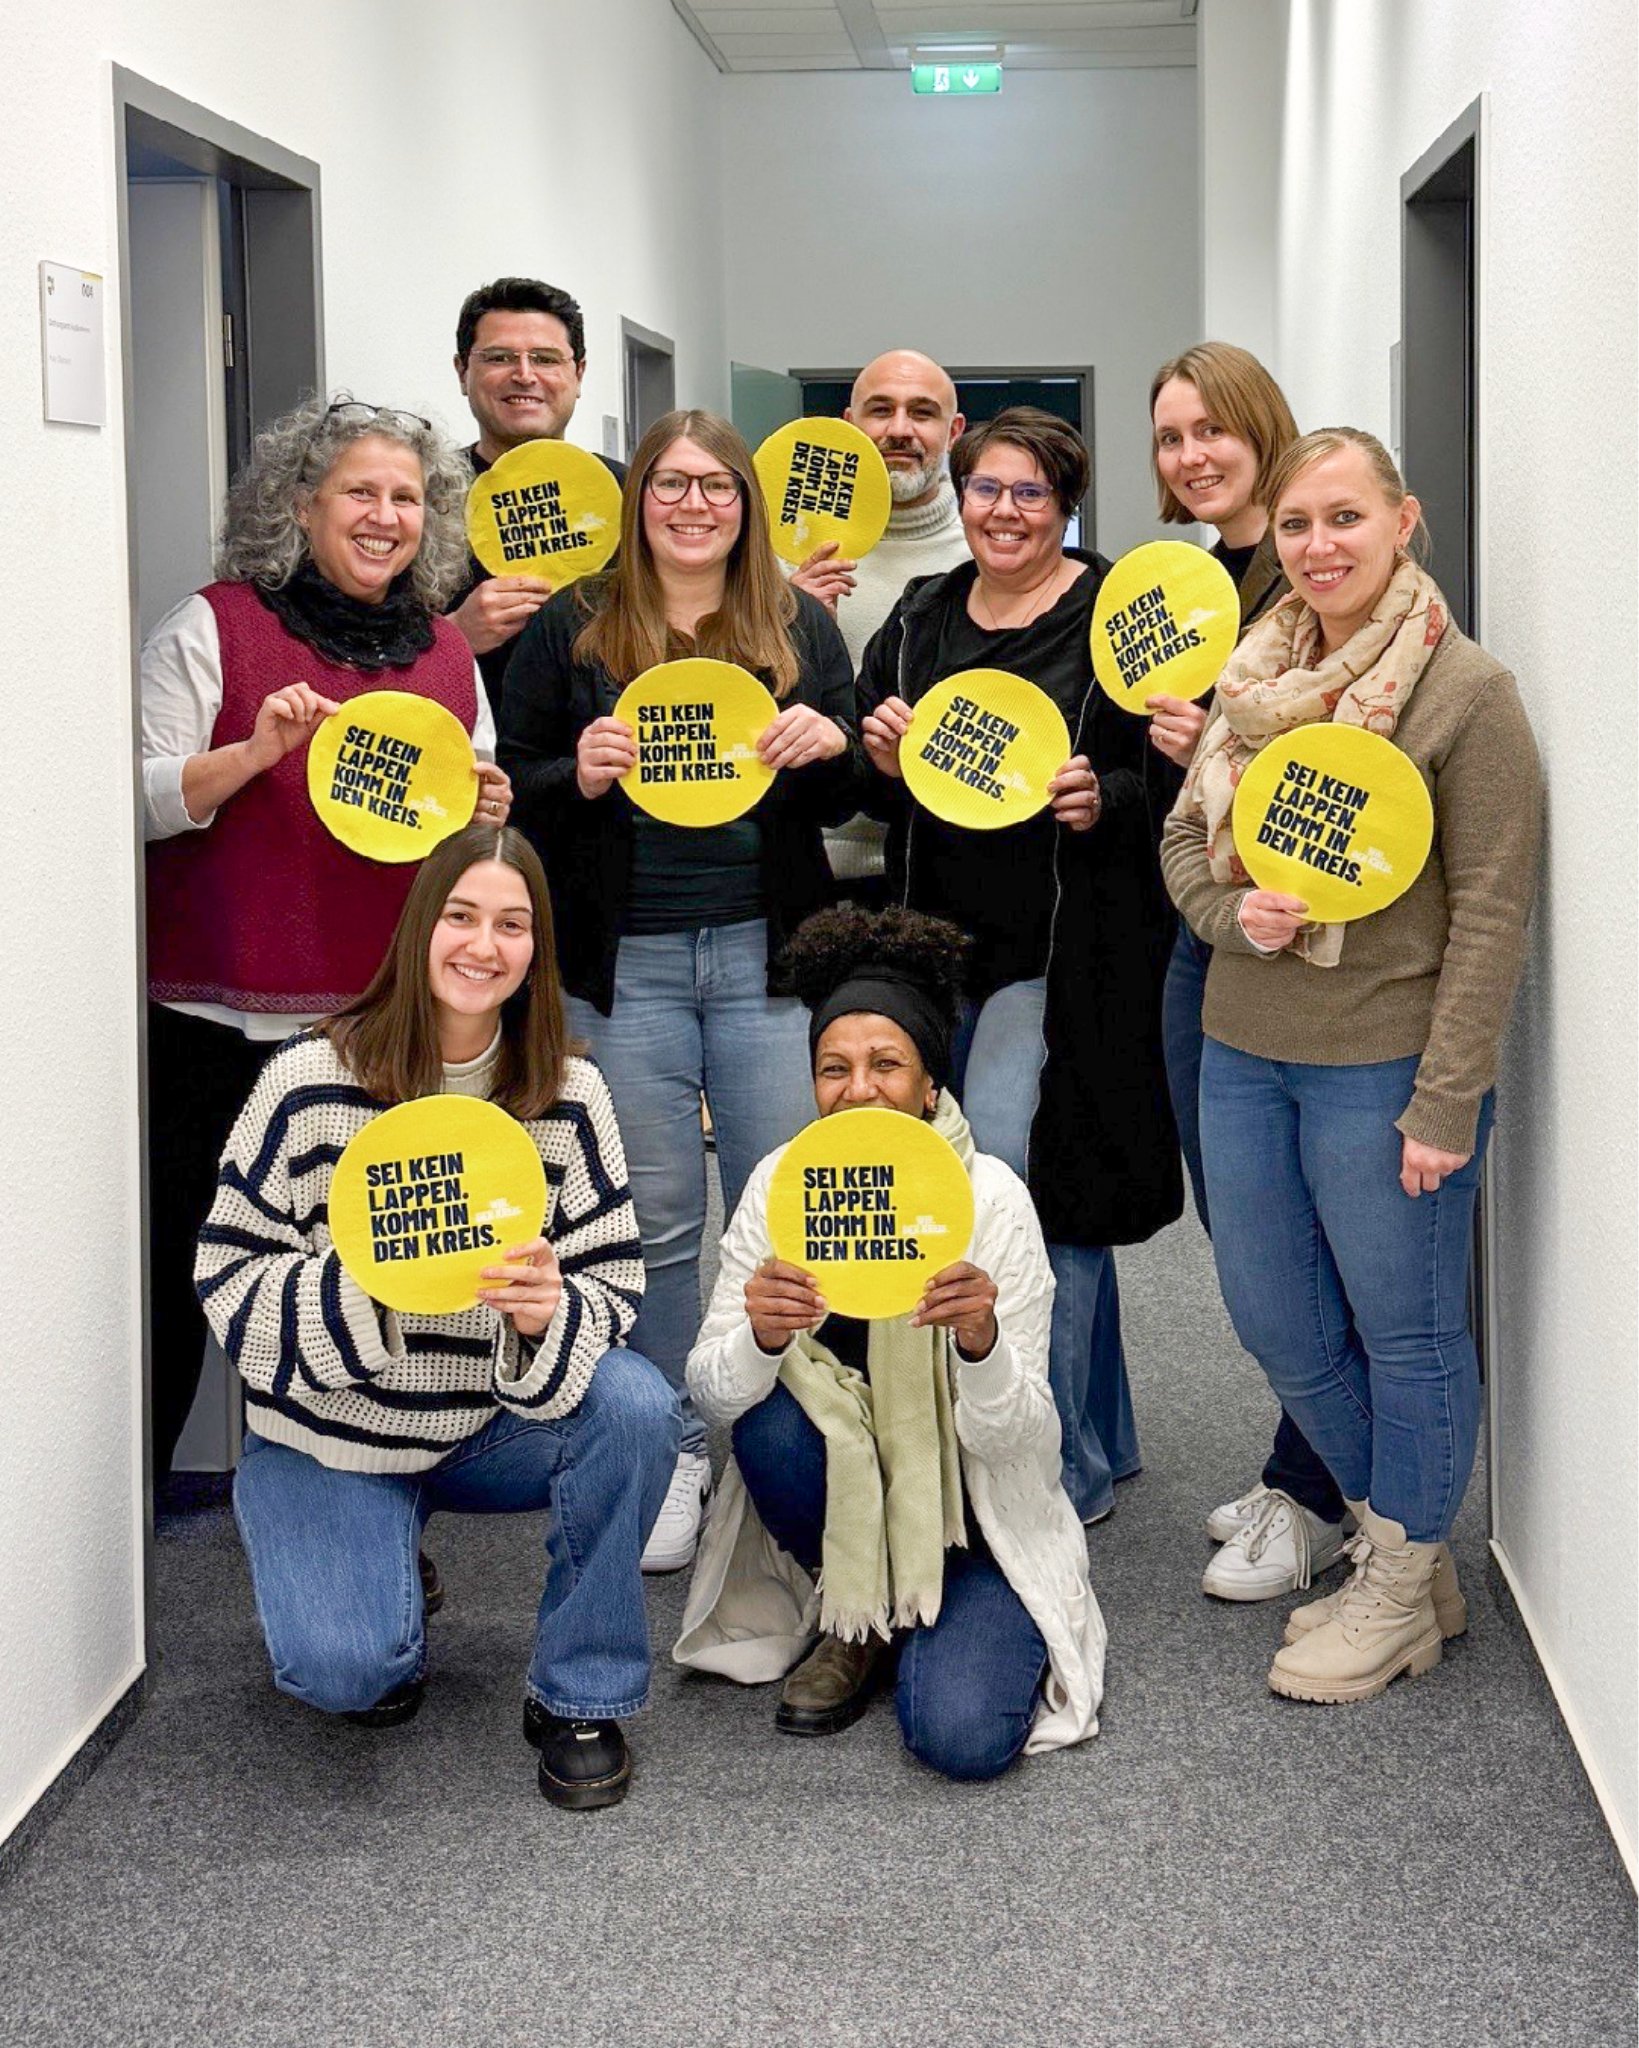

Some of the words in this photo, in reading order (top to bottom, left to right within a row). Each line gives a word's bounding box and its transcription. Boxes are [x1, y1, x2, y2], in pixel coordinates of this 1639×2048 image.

[790, 441, 811, 473] DEN
[804, 445, 827, 491] KOMM
[842, 452, 859, 479] SEI
[491, 490, 518, 509] SEI
[520, 481, 561, 505] KEIN
[780, 476, 804, 526] KREIS.
[816, 449, 843, 514] LAPPEN.
[833, 481, 854, 520] KEIN
[495, 499, 566, 527] LAPPEN.
[800, 493, 818, 511] IN
[499, 522, 546, 544] KOMM
[549, 516, 568, 535] IN
[503, 540, 536, 561] DEN
[539, 531, 593, 555] KREIS.
[1105, 611, 1128, 637] SEI
[1128, 585, 1165, 620] KEIN
[1111, 605, 1172, 655] LAPPEN.
[1116, 631, 1158, 671] KOMM
[1159, 619, 1178, 642] IN
[1122, 660, 1150, 689] DEN
[1152, 629, 1206, 666] KREIS.
[638, 705, 666, 723] SEI
[671, 703, 714, 722] KEIN
[639, 722, 716, 743] LAPPEN.
[950, 696, 979, 720] SEI
[977, 711, 1019, 742] KEIN
[345, 725, 375, 750] SEI
[376, 735, 422, 765] KEIN
[640, 743, 692, 763] KOMM
[697, 742, 716, 760] IN
[930, 728, 978, 765] KOMM
[978, 754, 1000, 775] IN
[940, 712, 1006, 759] LAPPEN.
[334, 763, 384, 795] KOMM
[386, 782, 408, 804] IN
[338, 744, 411, 785] LAPPEN.
[640, 764, 676, 783] DEN
[682, 762, 740, 781] KREIS.
[920, 743, 956, 772] DEN
[955, 763, 1005, 801] KREIS.
[1284, 761, 1318, 789] SEI
[1318, 775, 1369, 811] KEIN
[330, 783, 364, 807] DEN
[368, 795, 421, 829] KREIS.
[1273, 782, 1356, 834] LAPPEN.
[1265, 803, 1325, 842] KOMM
[1325, 828, 1351, 855] IN
[1257, 823, 1298, 856] DEN
[1299, 842, 1362, 886] KREIS.
[366, 1161, 403, 1187] SEI
[409, 1152, 464, 1181] KEIN
[804, 1167, 836, 1189] SEI
[843, 1165, 894, 1189] KEIN
[369, 1178, 469, 1212] LAPPEN.
[805, 1189, 896, 1212] LAPPEN.
[371, 1208, 438, 1238] KOMM
[444, 1203, 469, 1227] IN
[805, 1215, 867, 1237] KOMM
[873, 1214, 895, 1236] IN
[374, 1236, 419, 1263] DEN
[426, 1224, 501, 1256] KREIS.
[806, 1240, 848, 1261] DEN
[855, 1238, 925, 1260] KREIS.
